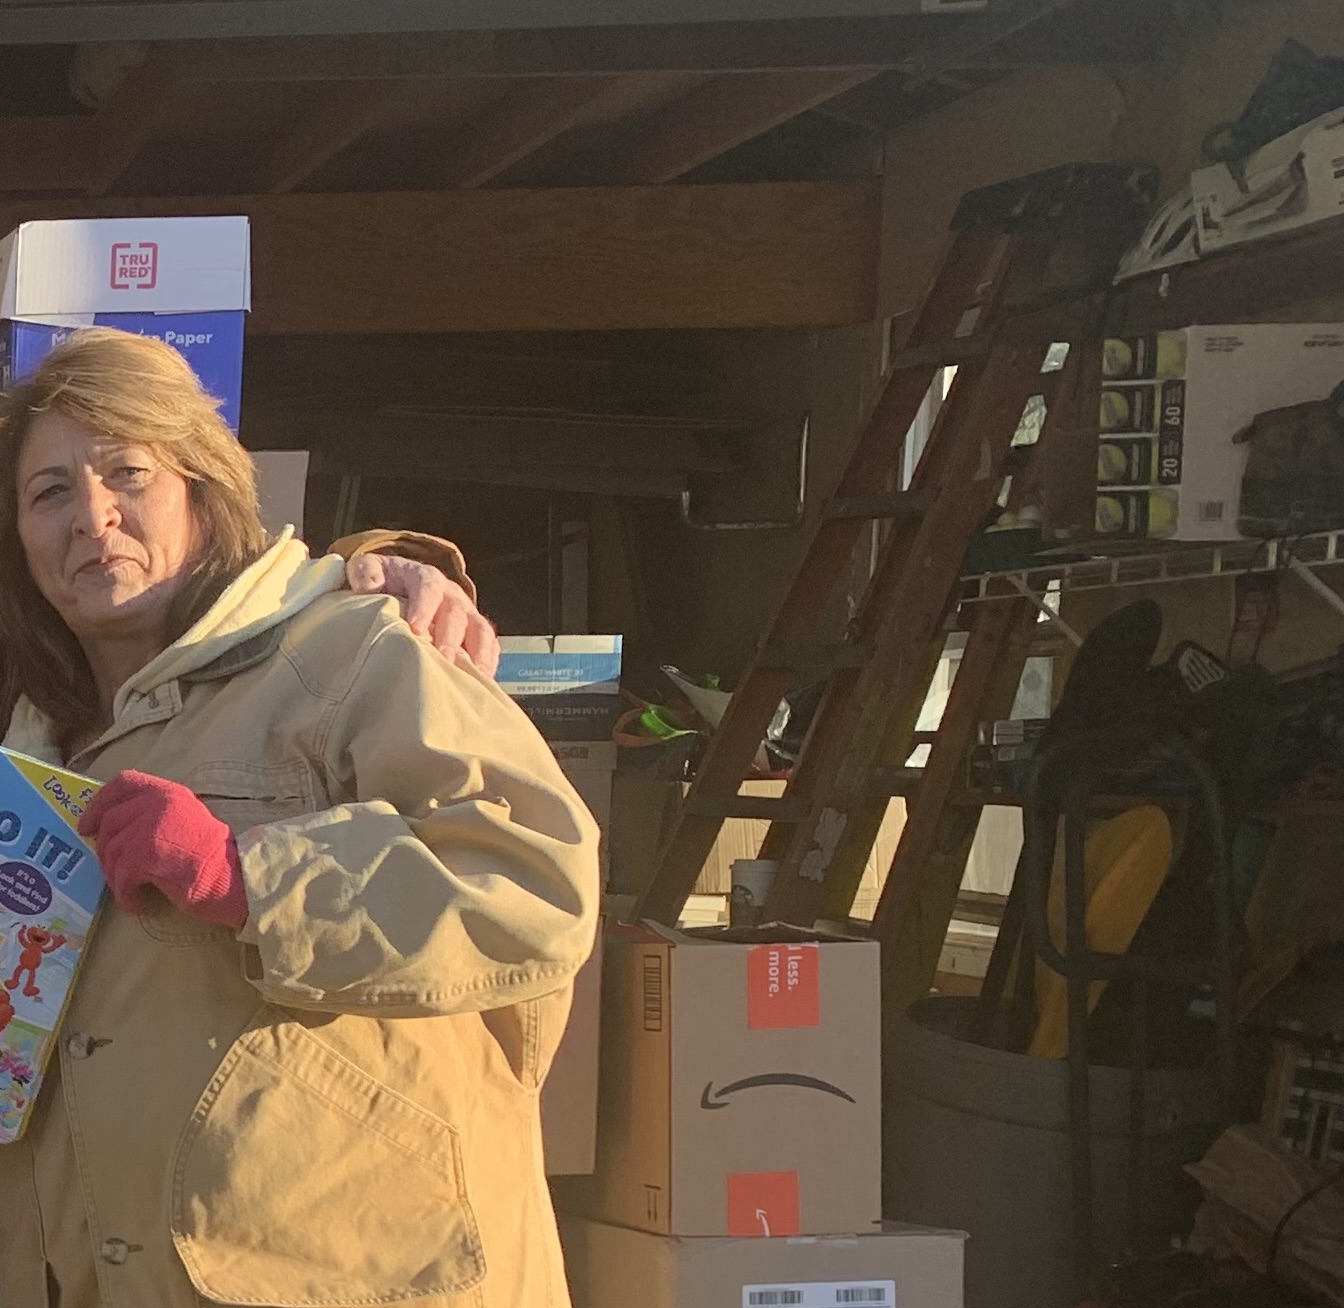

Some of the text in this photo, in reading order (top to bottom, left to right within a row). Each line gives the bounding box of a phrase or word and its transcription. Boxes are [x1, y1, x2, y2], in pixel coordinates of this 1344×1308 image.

[120, 255, 149, 265] TRU
[119, 268, 148, 278] RED
[165, 331, 213, 345] Paper
[25, 827, 85, 881] IT!
[768, 951, 780, 998] more.
[787, 955, 802, 991] less.
